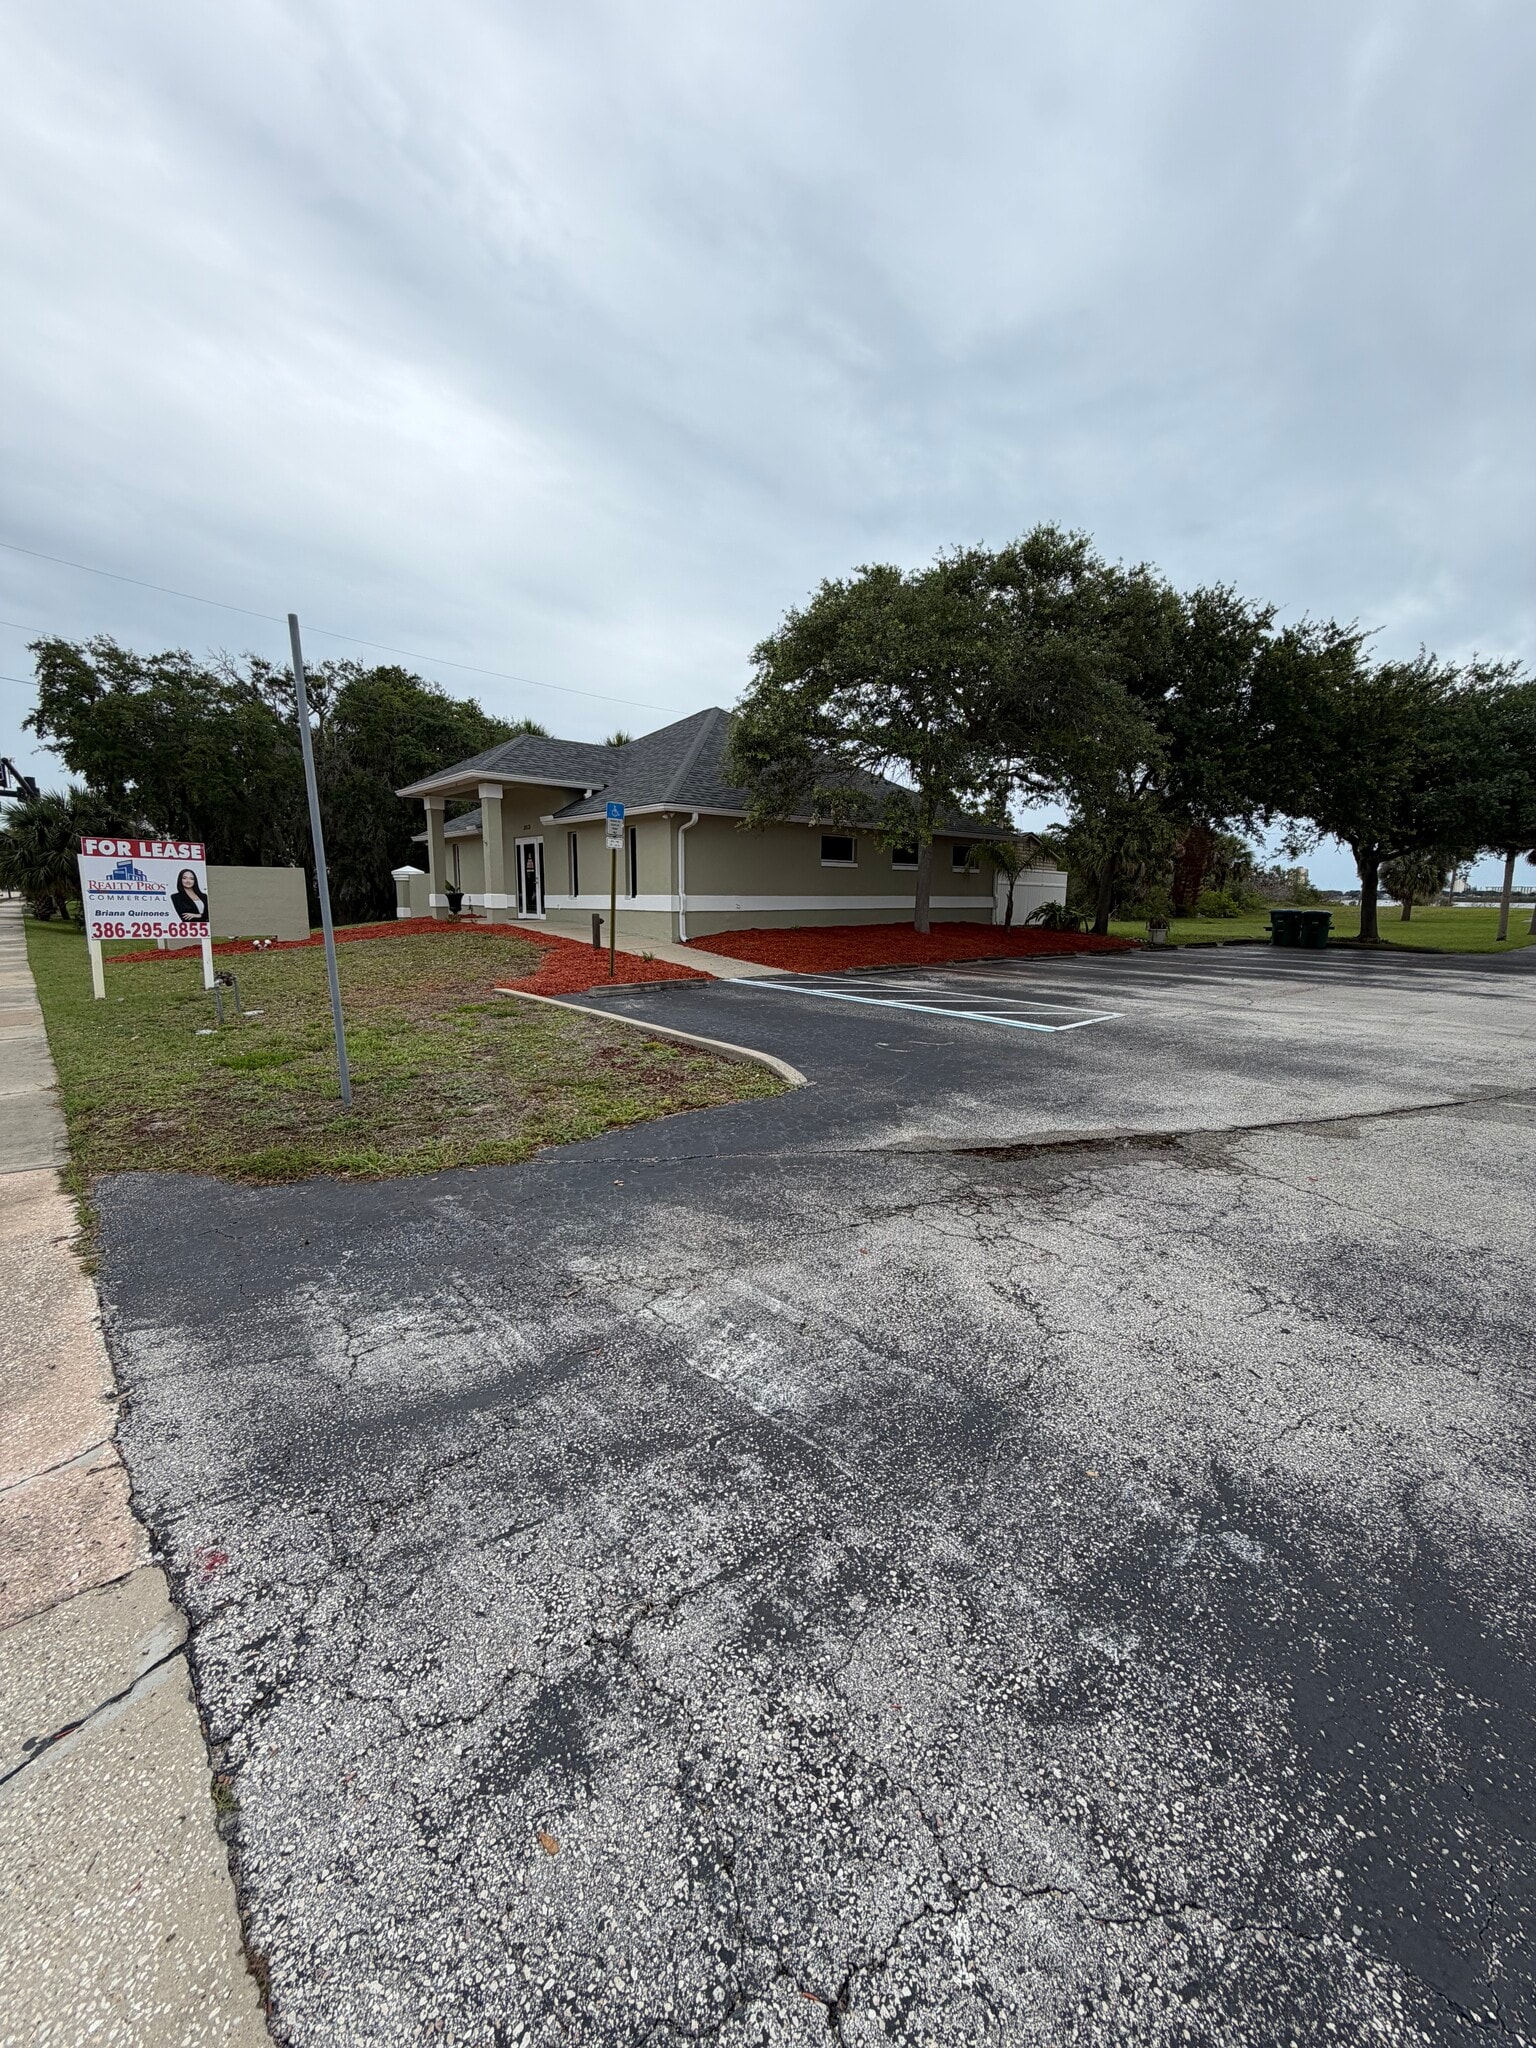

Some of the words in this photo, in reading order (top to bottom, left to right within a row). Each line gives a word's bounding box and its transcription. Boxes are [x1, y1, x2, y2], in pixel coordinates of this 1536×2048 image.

[85, 839, 132, 856] FOR
[139, 842, 202, 859] LEASE
[88, 880, 133, 890] REALTY
[137, 881, 167, 890] PROS
[89, 894, 167, 902] COMMERCIAL
[95, 909, 125, 917] Briana
[92, 922, 209, 938] 386-295-6855
